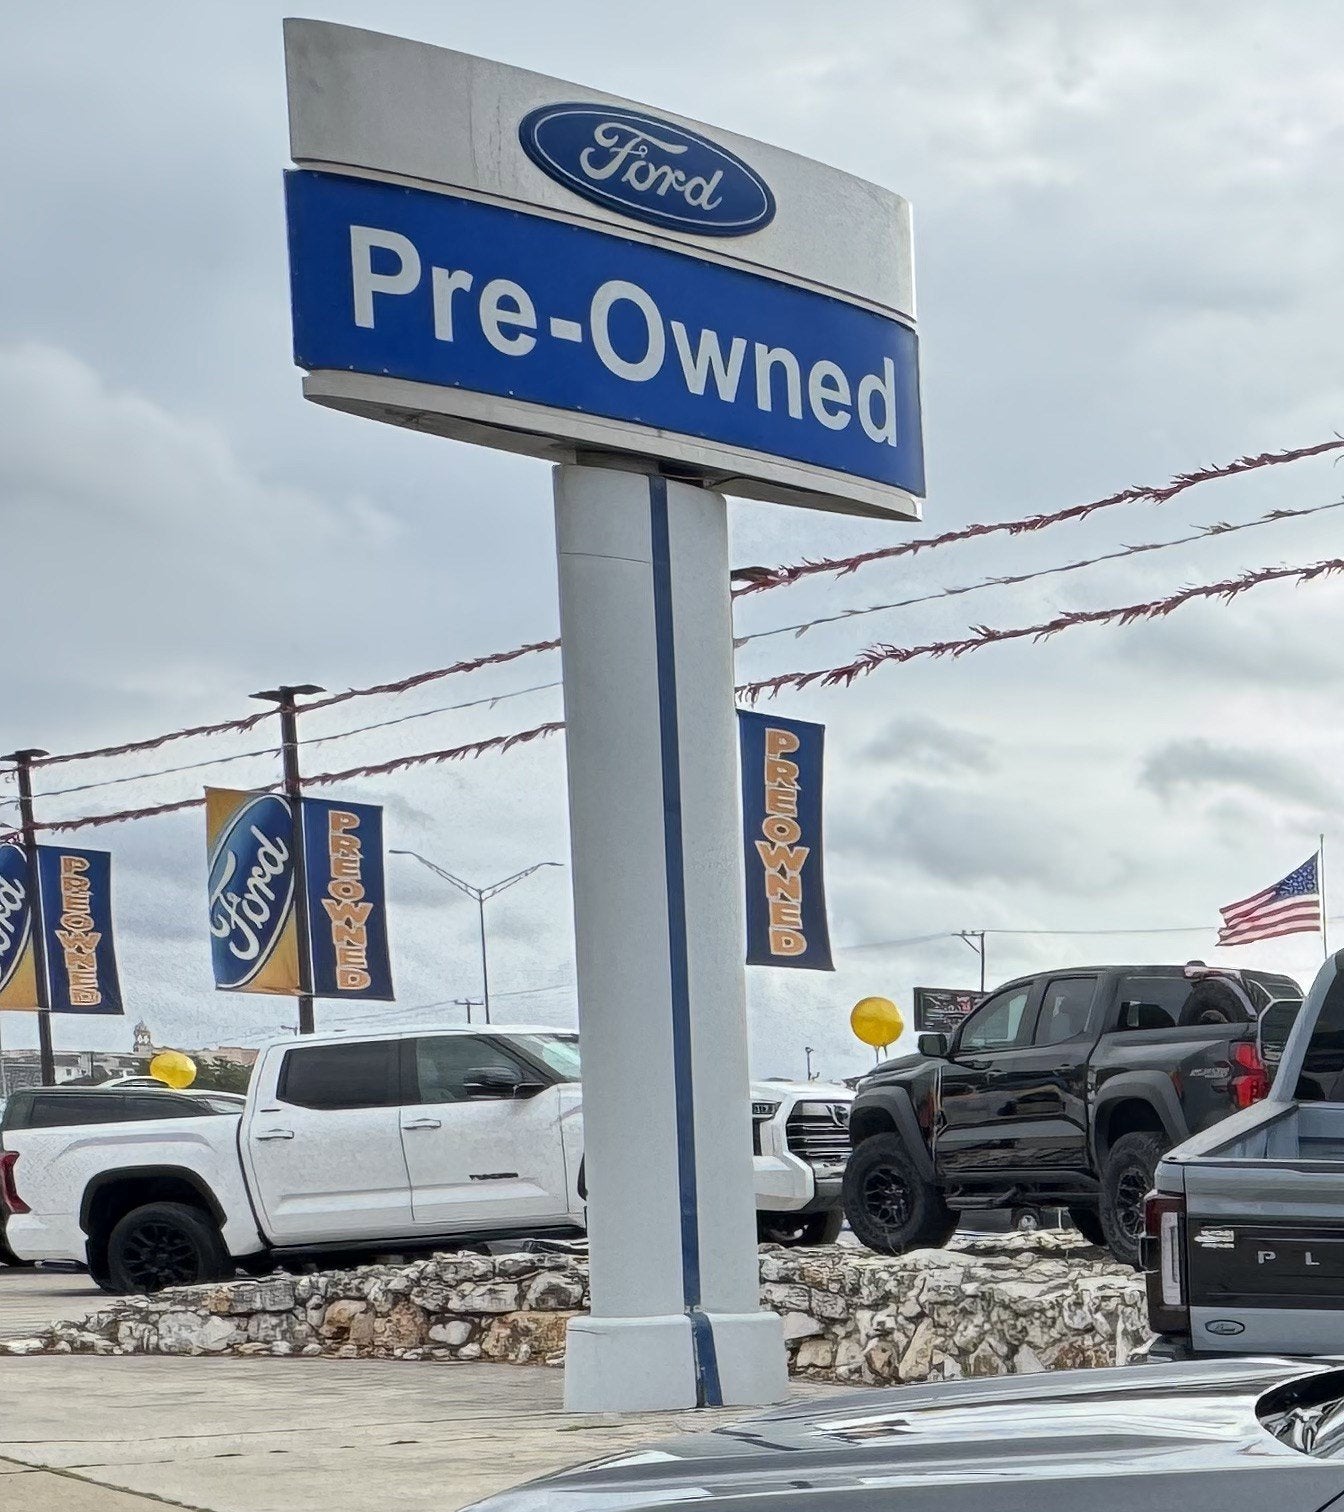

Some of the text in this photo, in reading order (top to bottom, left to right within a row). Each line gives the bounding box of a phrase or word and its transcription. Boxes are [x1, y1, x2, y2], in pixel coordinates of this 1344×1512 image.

[579, 121, 722, 212] Ford
[348, 224, 898, 448] Pre-Owned
[209, 824, 290, 961] Ford
[324, 809, 373, 991] PREOWNED
[753, 727, 810, 957] PREOWNED
